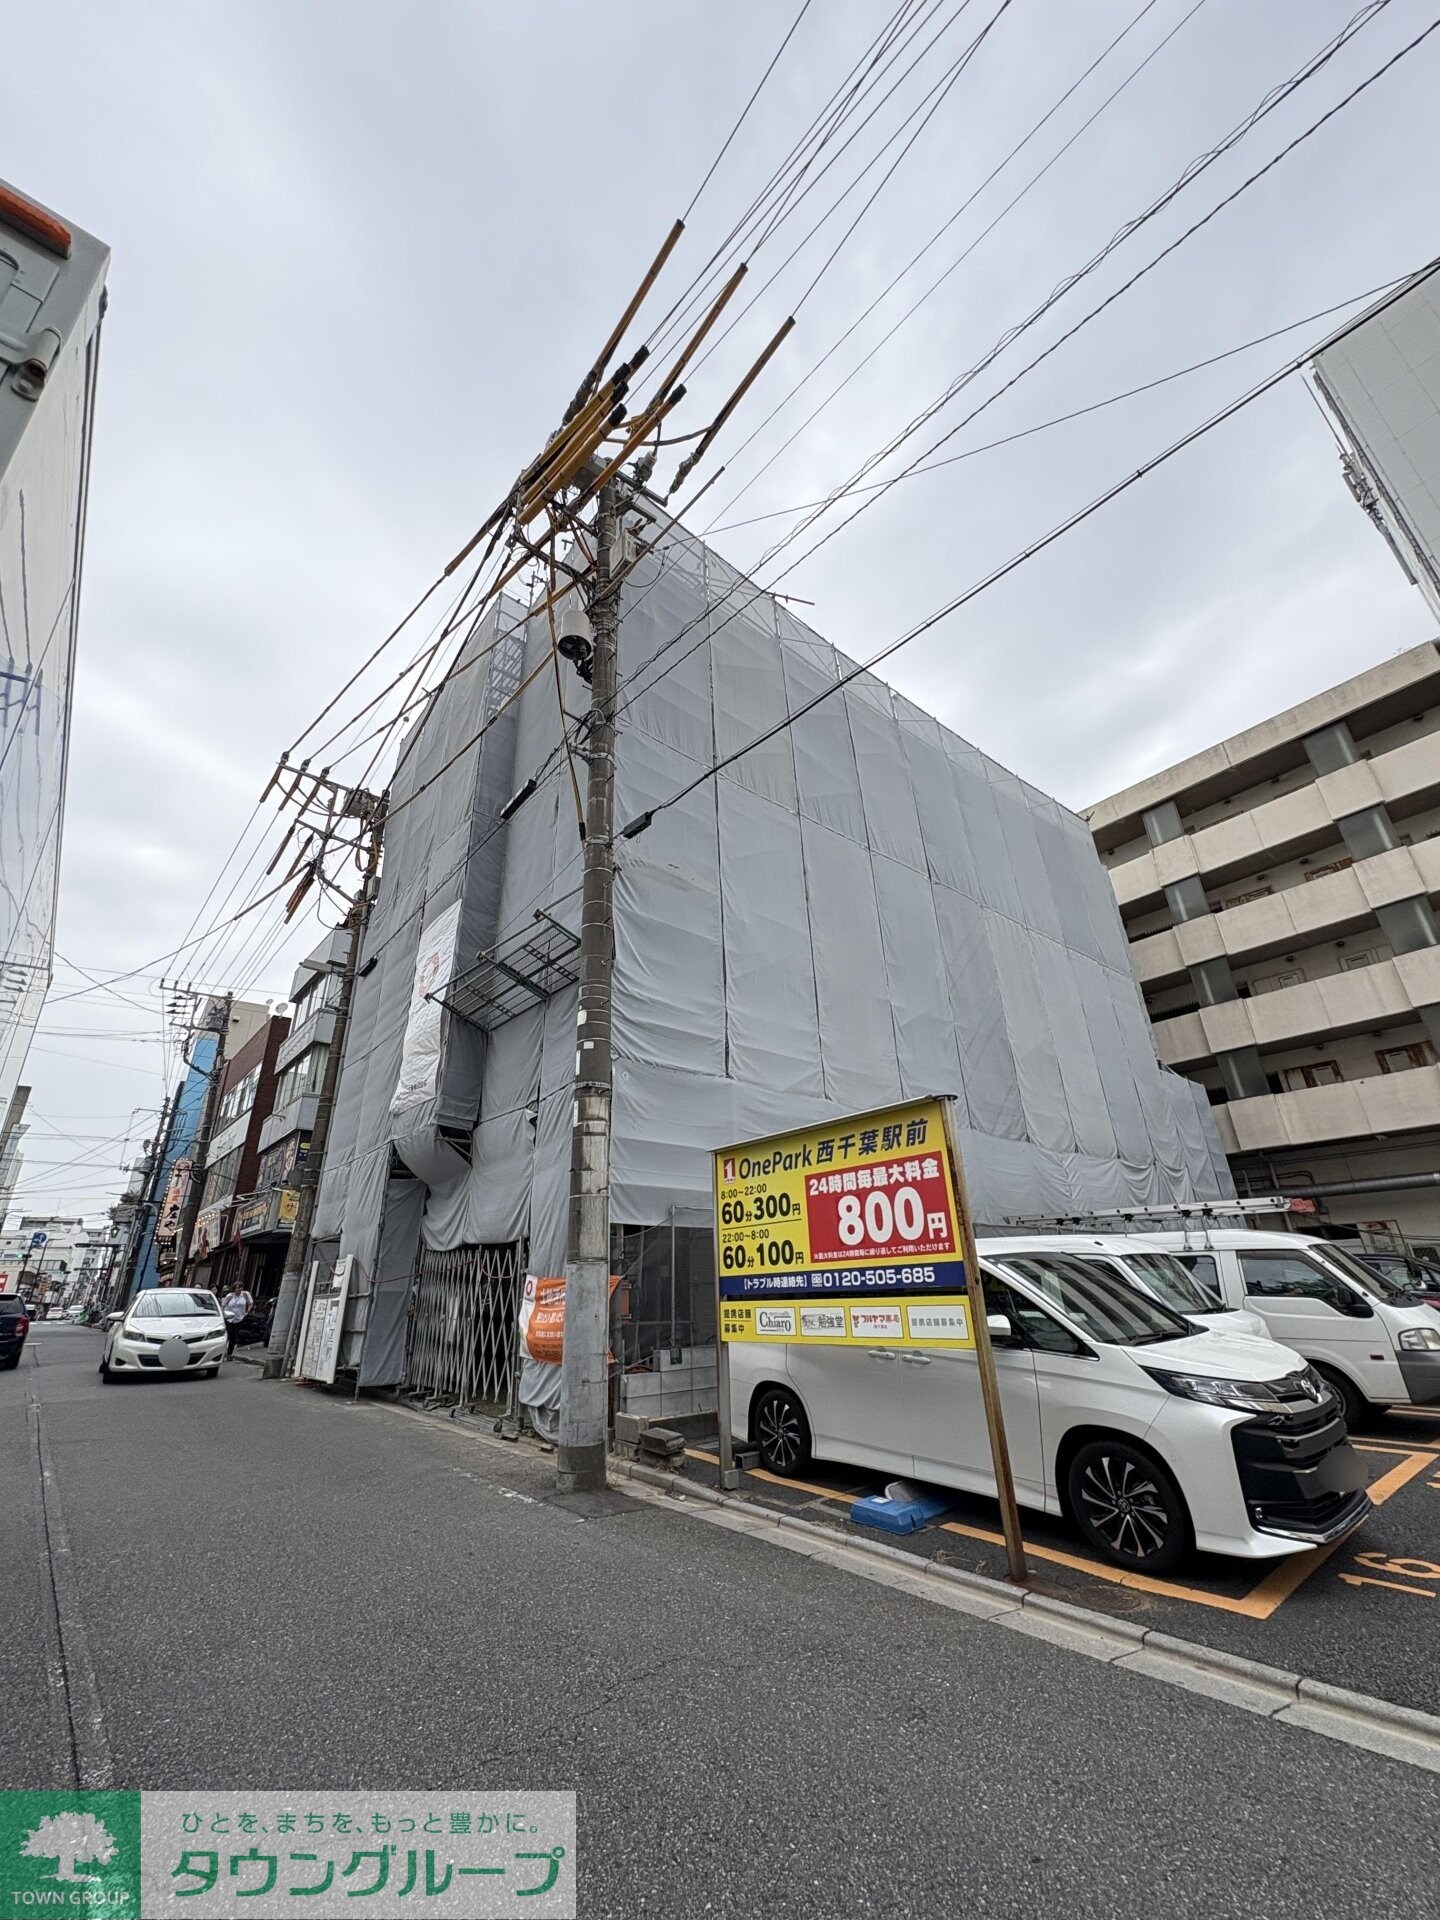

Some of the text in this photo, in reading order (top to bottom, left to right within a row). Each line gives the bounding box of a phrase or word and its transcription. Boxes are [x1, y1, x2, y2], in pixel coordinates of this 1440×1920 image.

[739, 1144, 813, 1180] OnePark
[816, 1118, 928, 1165] 西千葉駅前
[809, 1158, 940, 1196] 24時間毎最大料金
[721, 1193, 801, 1225] 60分300円
[837, 1186, 949, 1246] 800円
[723, 1239, 805, 1270] 60分100円
[823, 1266, 936, 1288] 0120-505-685
[724, 1323, 745, 1335] 募集中
[759, 1311, 792, 1332] Chiaro
